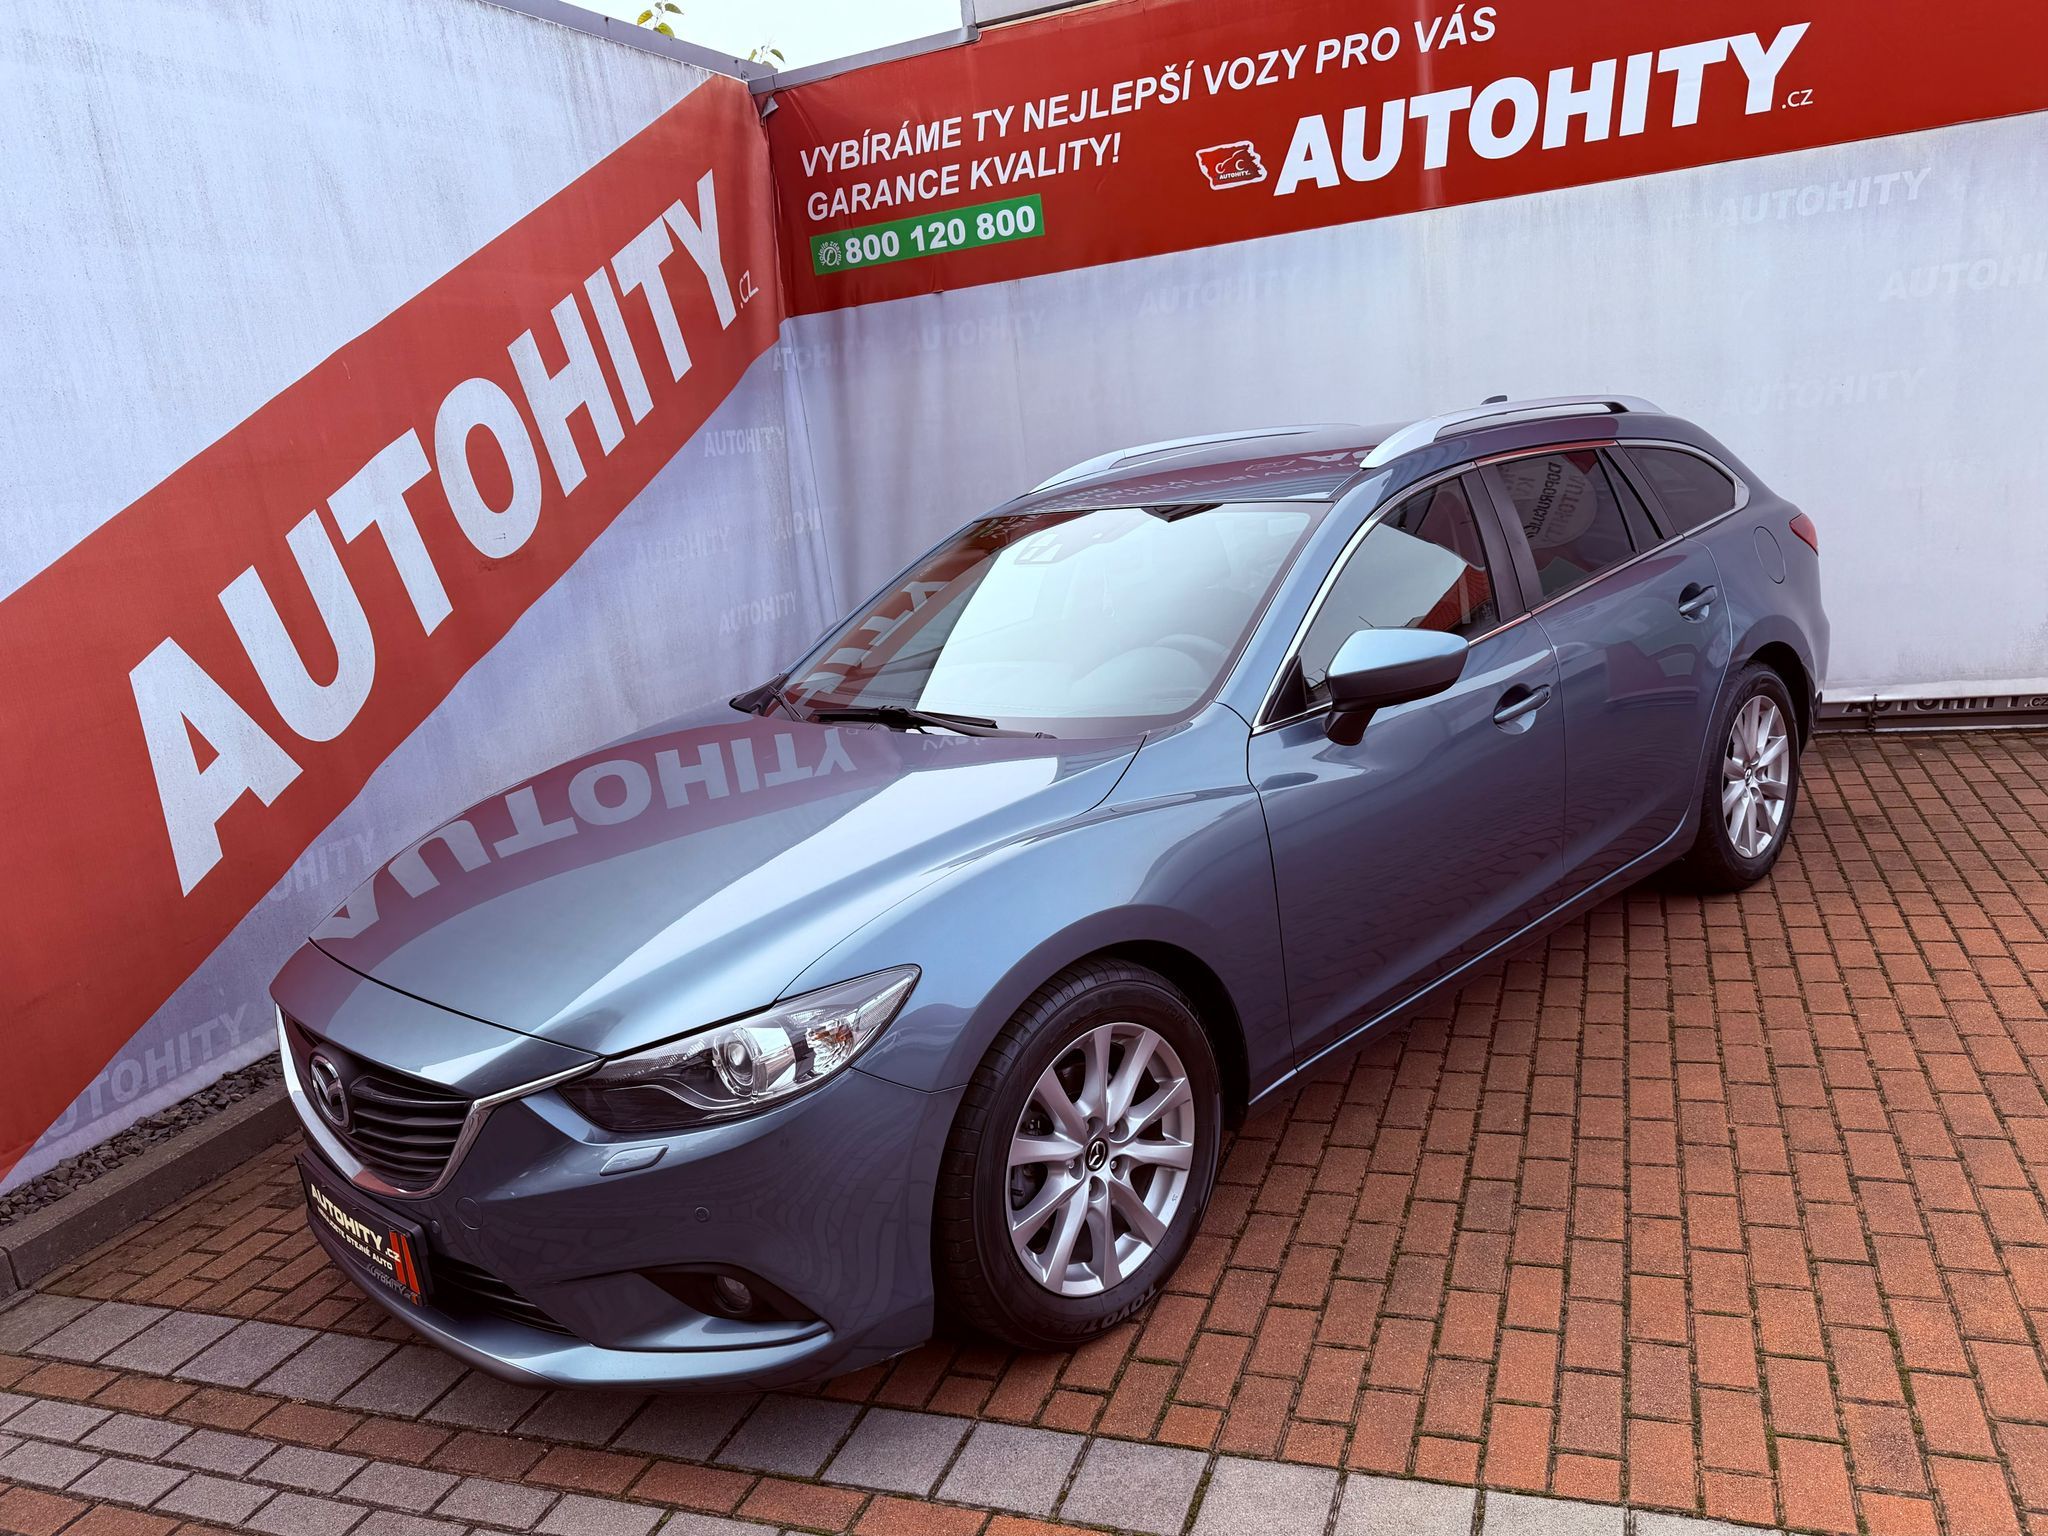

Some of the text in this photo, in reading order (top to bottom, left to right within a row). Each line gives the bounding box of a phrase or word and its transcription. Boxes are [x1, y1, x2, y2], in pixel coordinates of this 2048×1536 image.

[800, 4, 1497, 177] VYBÍRÁME TY NEJLEPŠÍ VOZY PRO VÁS
[807, 133, 1121, 221] GARANCE KVALITY!
[1718, 168, 1931, 226] AUTOHITY
[845, 206, 1035, 265] 800 120 800
[372, 1253, 393, 1270] AUTO
[1101, 1283, 1156, 1329] TOYO
